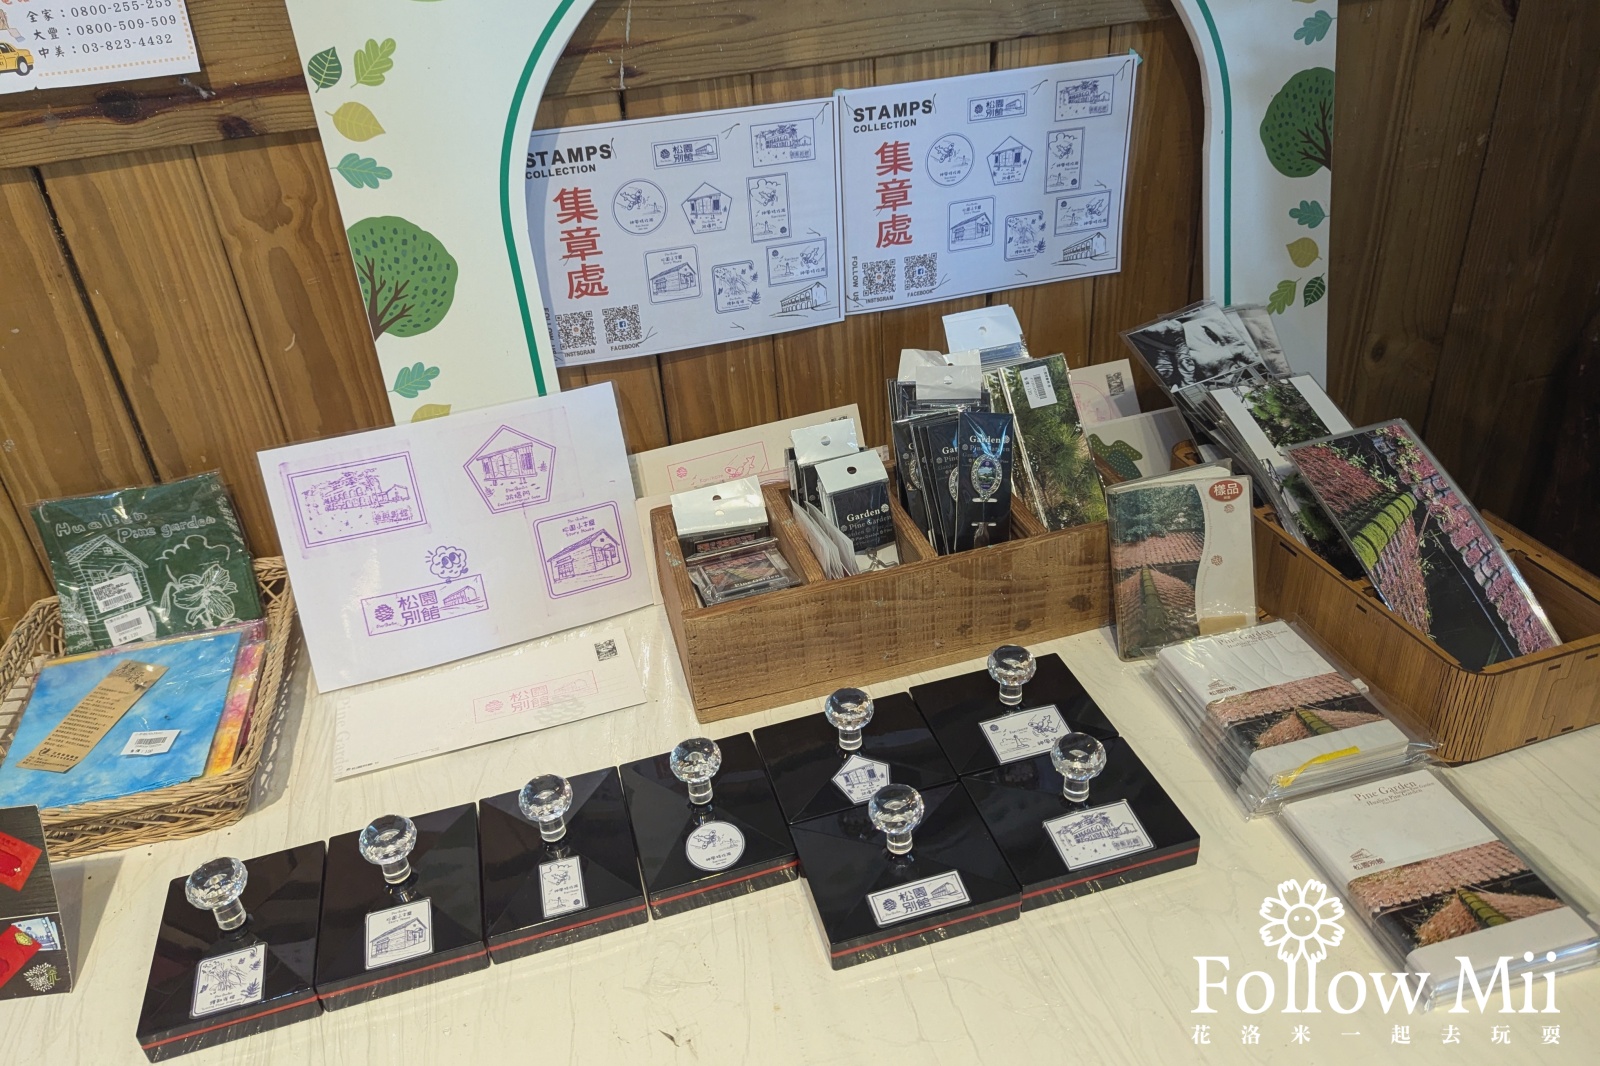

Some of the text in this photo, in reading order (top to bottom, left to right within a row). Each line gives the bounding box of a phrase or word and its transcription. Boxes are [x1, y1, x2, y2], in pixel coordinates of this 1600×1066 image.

[853, 99, 933, 122] STAMPS
[853, 118, 917, 133] COLLECTION
[526, 143, 611, 168] STAMPS
[525, 164, 596, 179] COLLECTION
[874, 140, 913, 249] 集章處
[553, 186, 609, 300] 集章處
[851, 256, 859, 288] FOLLOW
[907, 289, 933, 298] FACEBOOK
[610, 342, 640, 351] FACEBOOK
[1213, 482, 1239, 497] 樣品
[846, 508, 881, 522] Garden
[117, 515, 216, 543] Pine garden
[849, 522, 866, 530] Pine
[397, 589, 439, 611] 松園
[401, 606, 440, 626] 別館
[1239, 629, 1273, 641] Garden
[511, 696, 550, 712] 別館
[1354, 781, 1417, 801] Pine Garden
